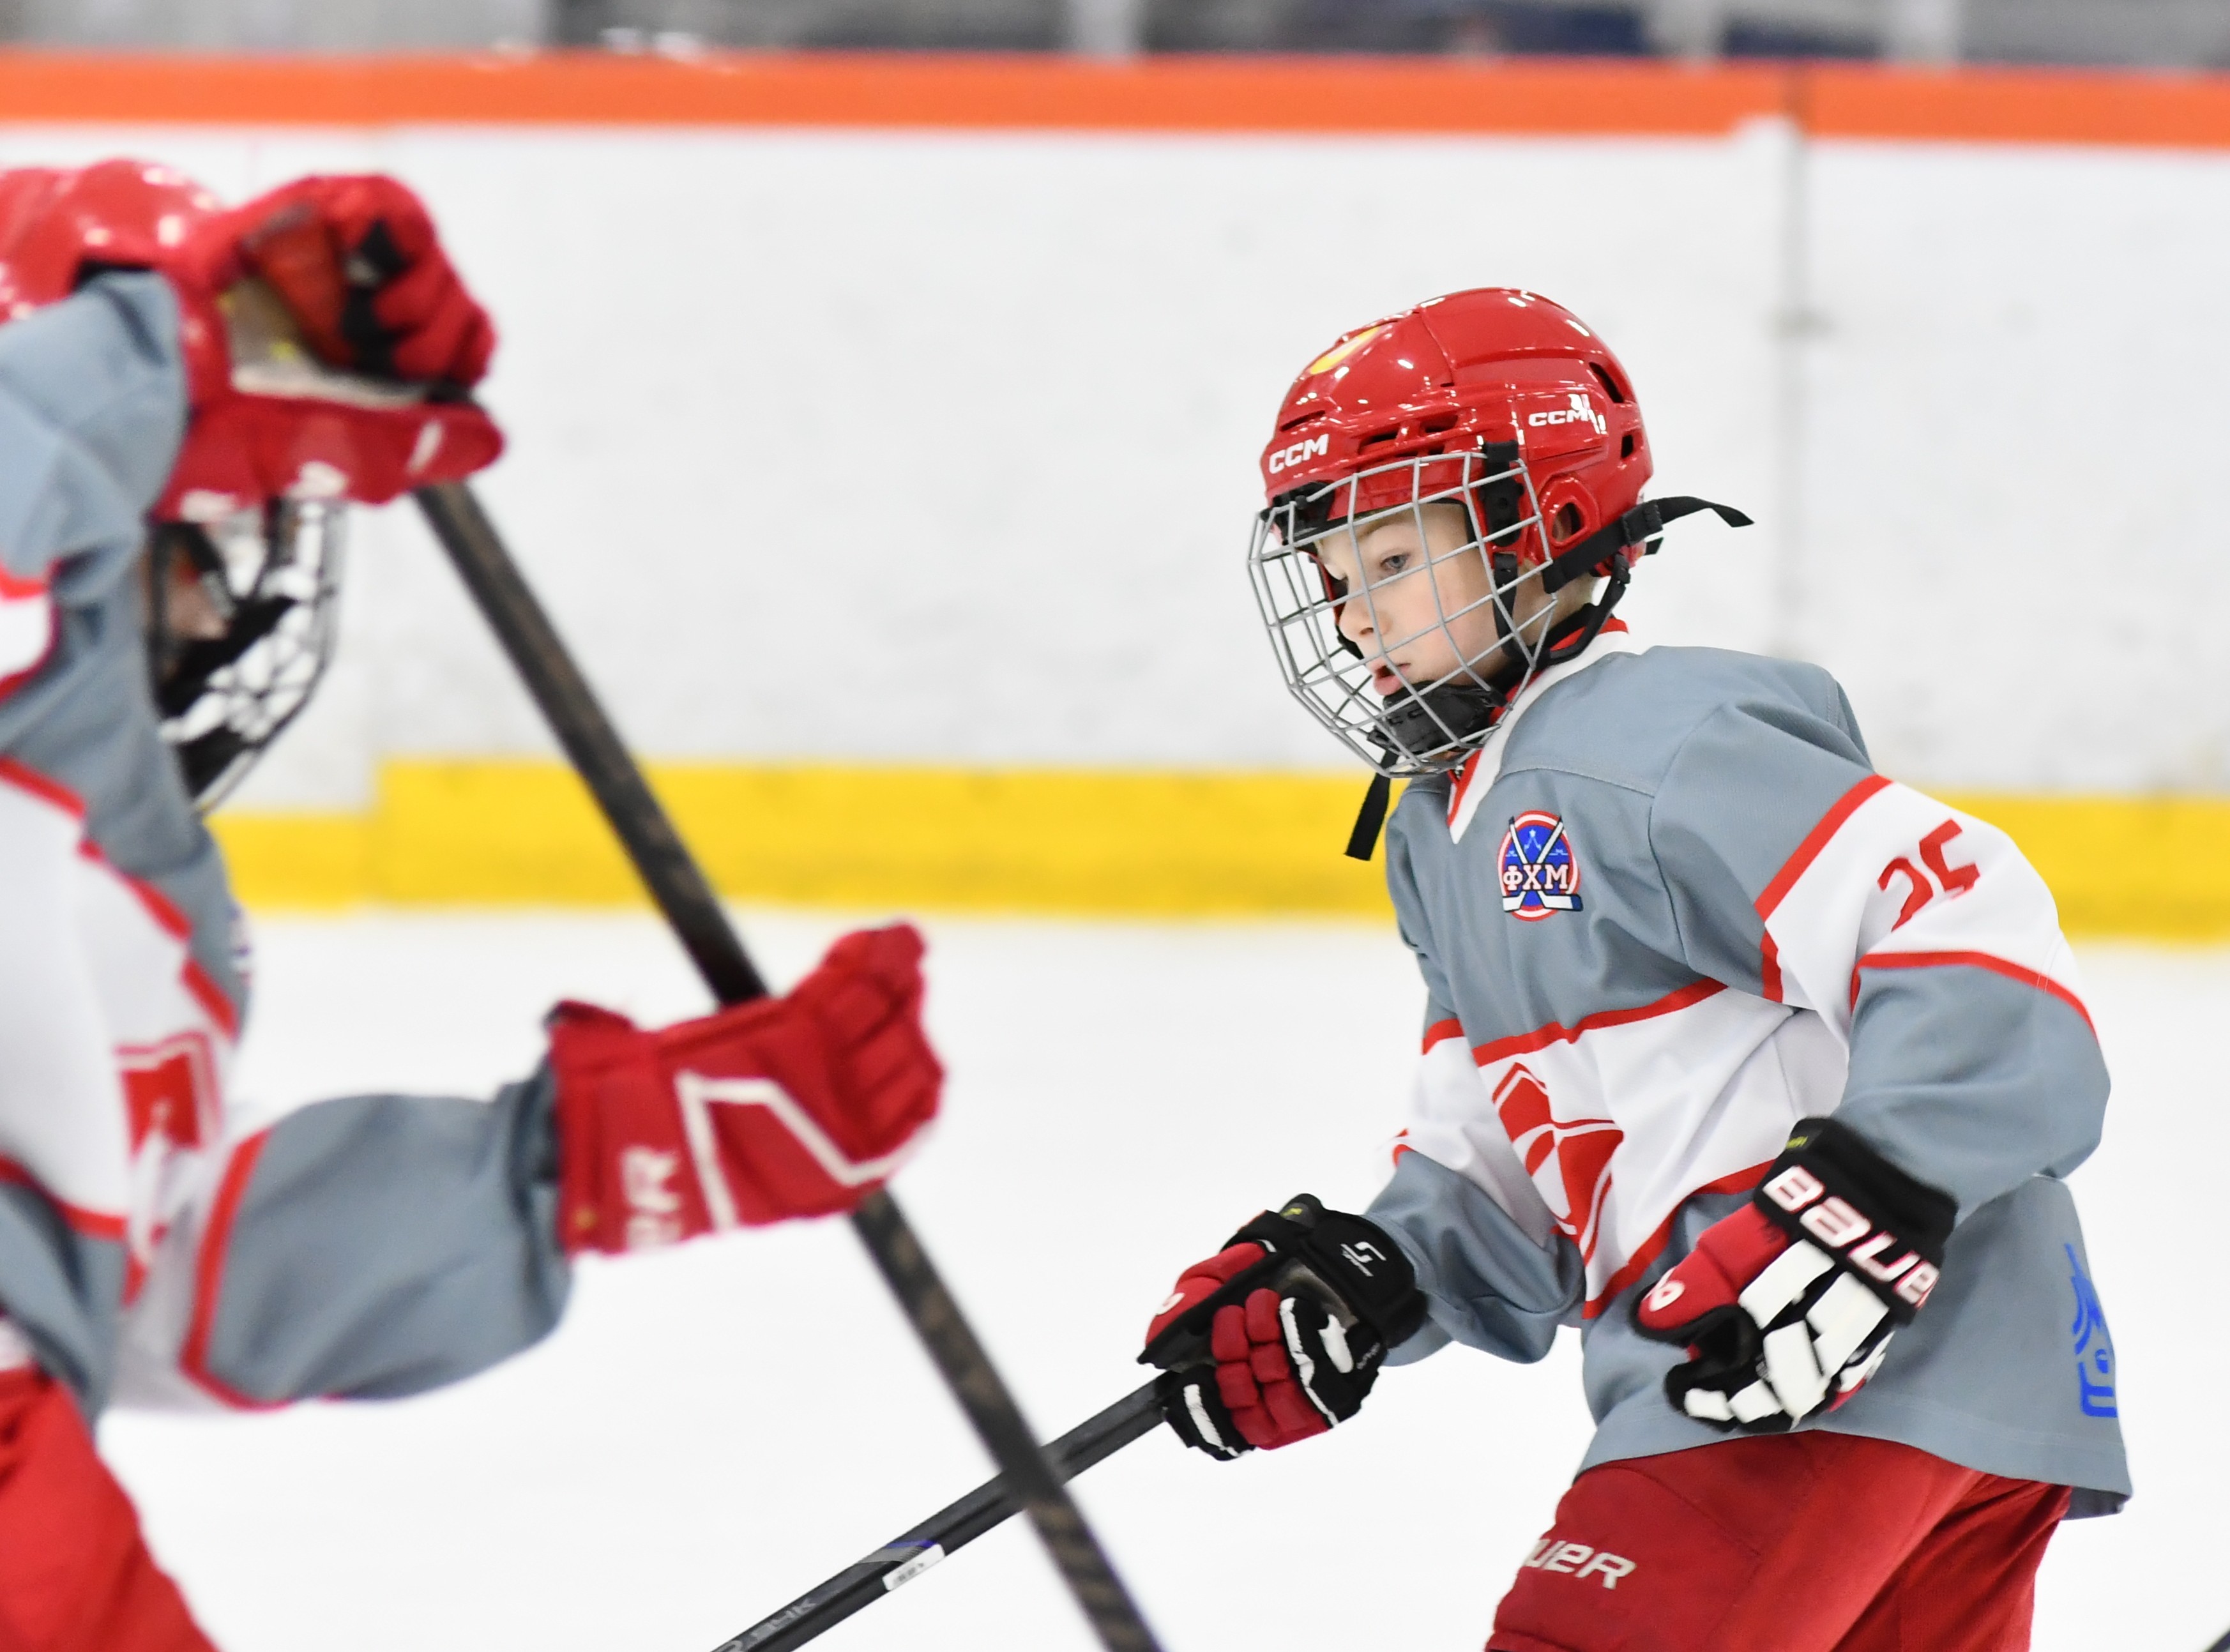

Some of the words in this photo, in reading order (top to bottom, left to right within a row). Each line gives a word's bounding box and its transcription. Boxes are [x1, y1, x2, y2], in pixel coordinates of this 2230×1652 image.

[1528, 409, 1589, 427] CCM
[1268, 433, 1330, 474] CCM
[1503, 864, 1569, 891] ФХМ
[1762, 1164, 1941, 1310] BAUE
